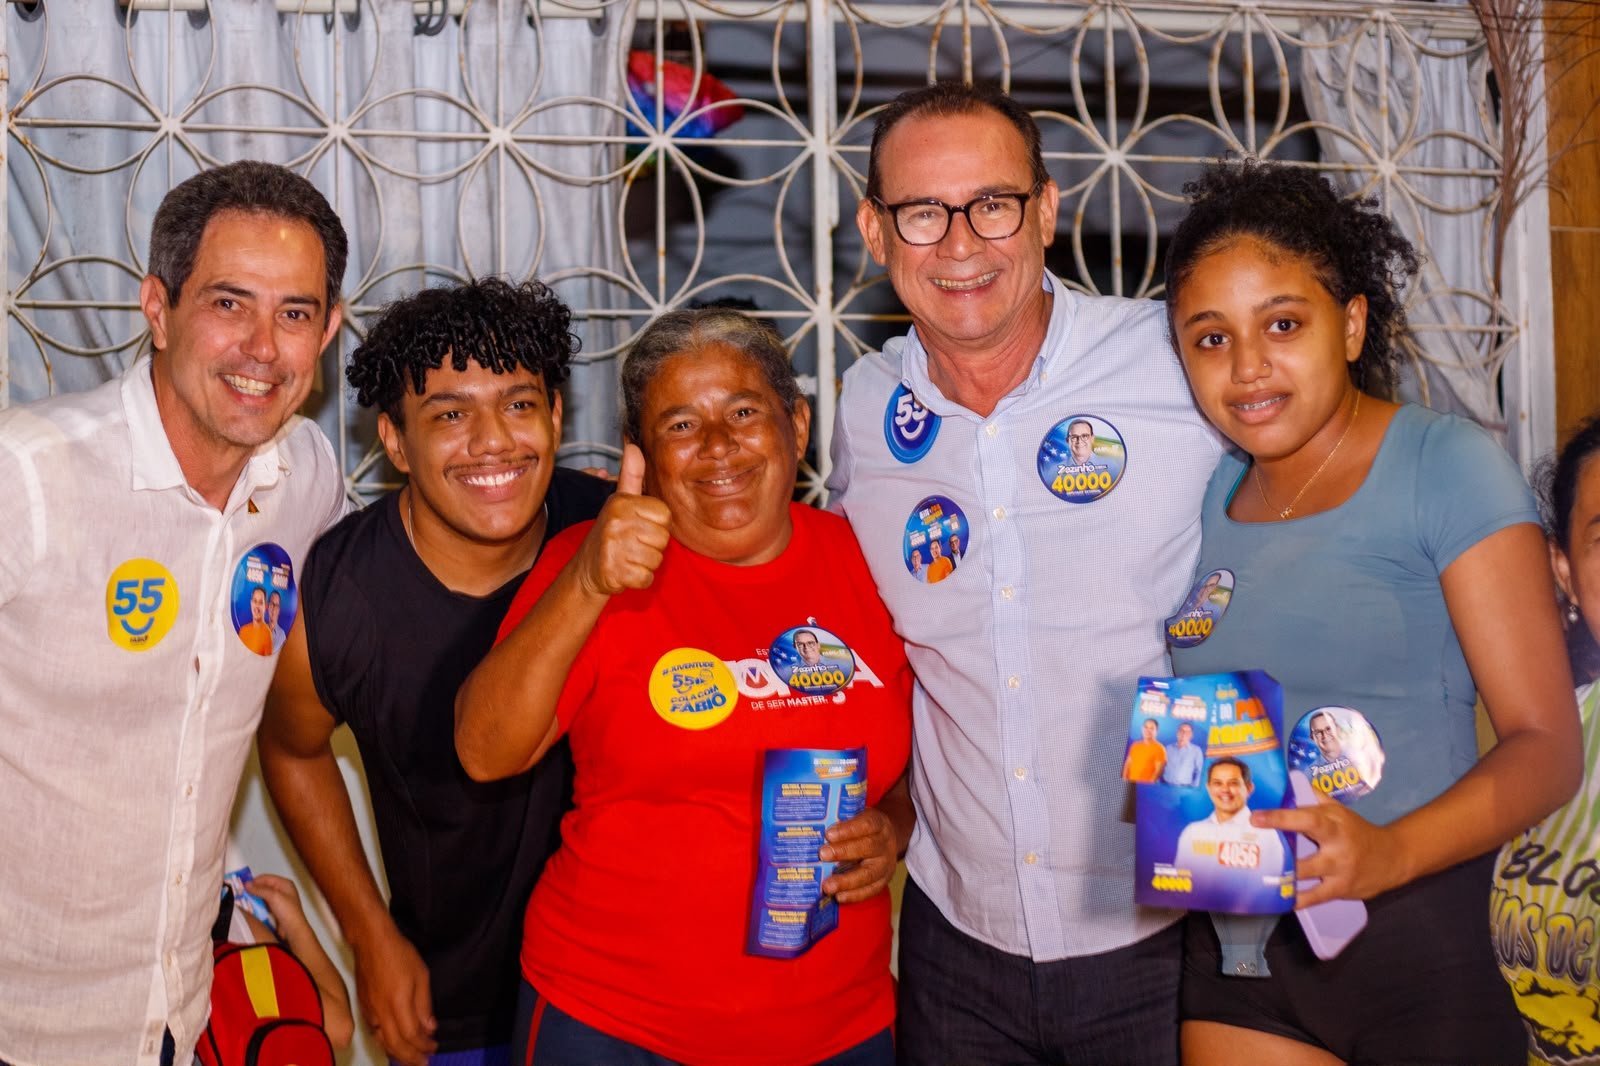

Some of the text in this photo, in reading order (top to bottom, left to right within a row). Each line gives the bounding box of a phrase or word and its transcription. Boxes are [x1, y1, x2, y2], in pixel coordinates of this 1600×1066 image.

[1052, 471, 1112, 493] 40000
[113, 578, 165, 616] 55
[789, 669, 845, 688] 40000
[750, 701, 766, 711] DE
[766, 699, 786, 710] SER
[1501, 842, 1600, 904] BLO
